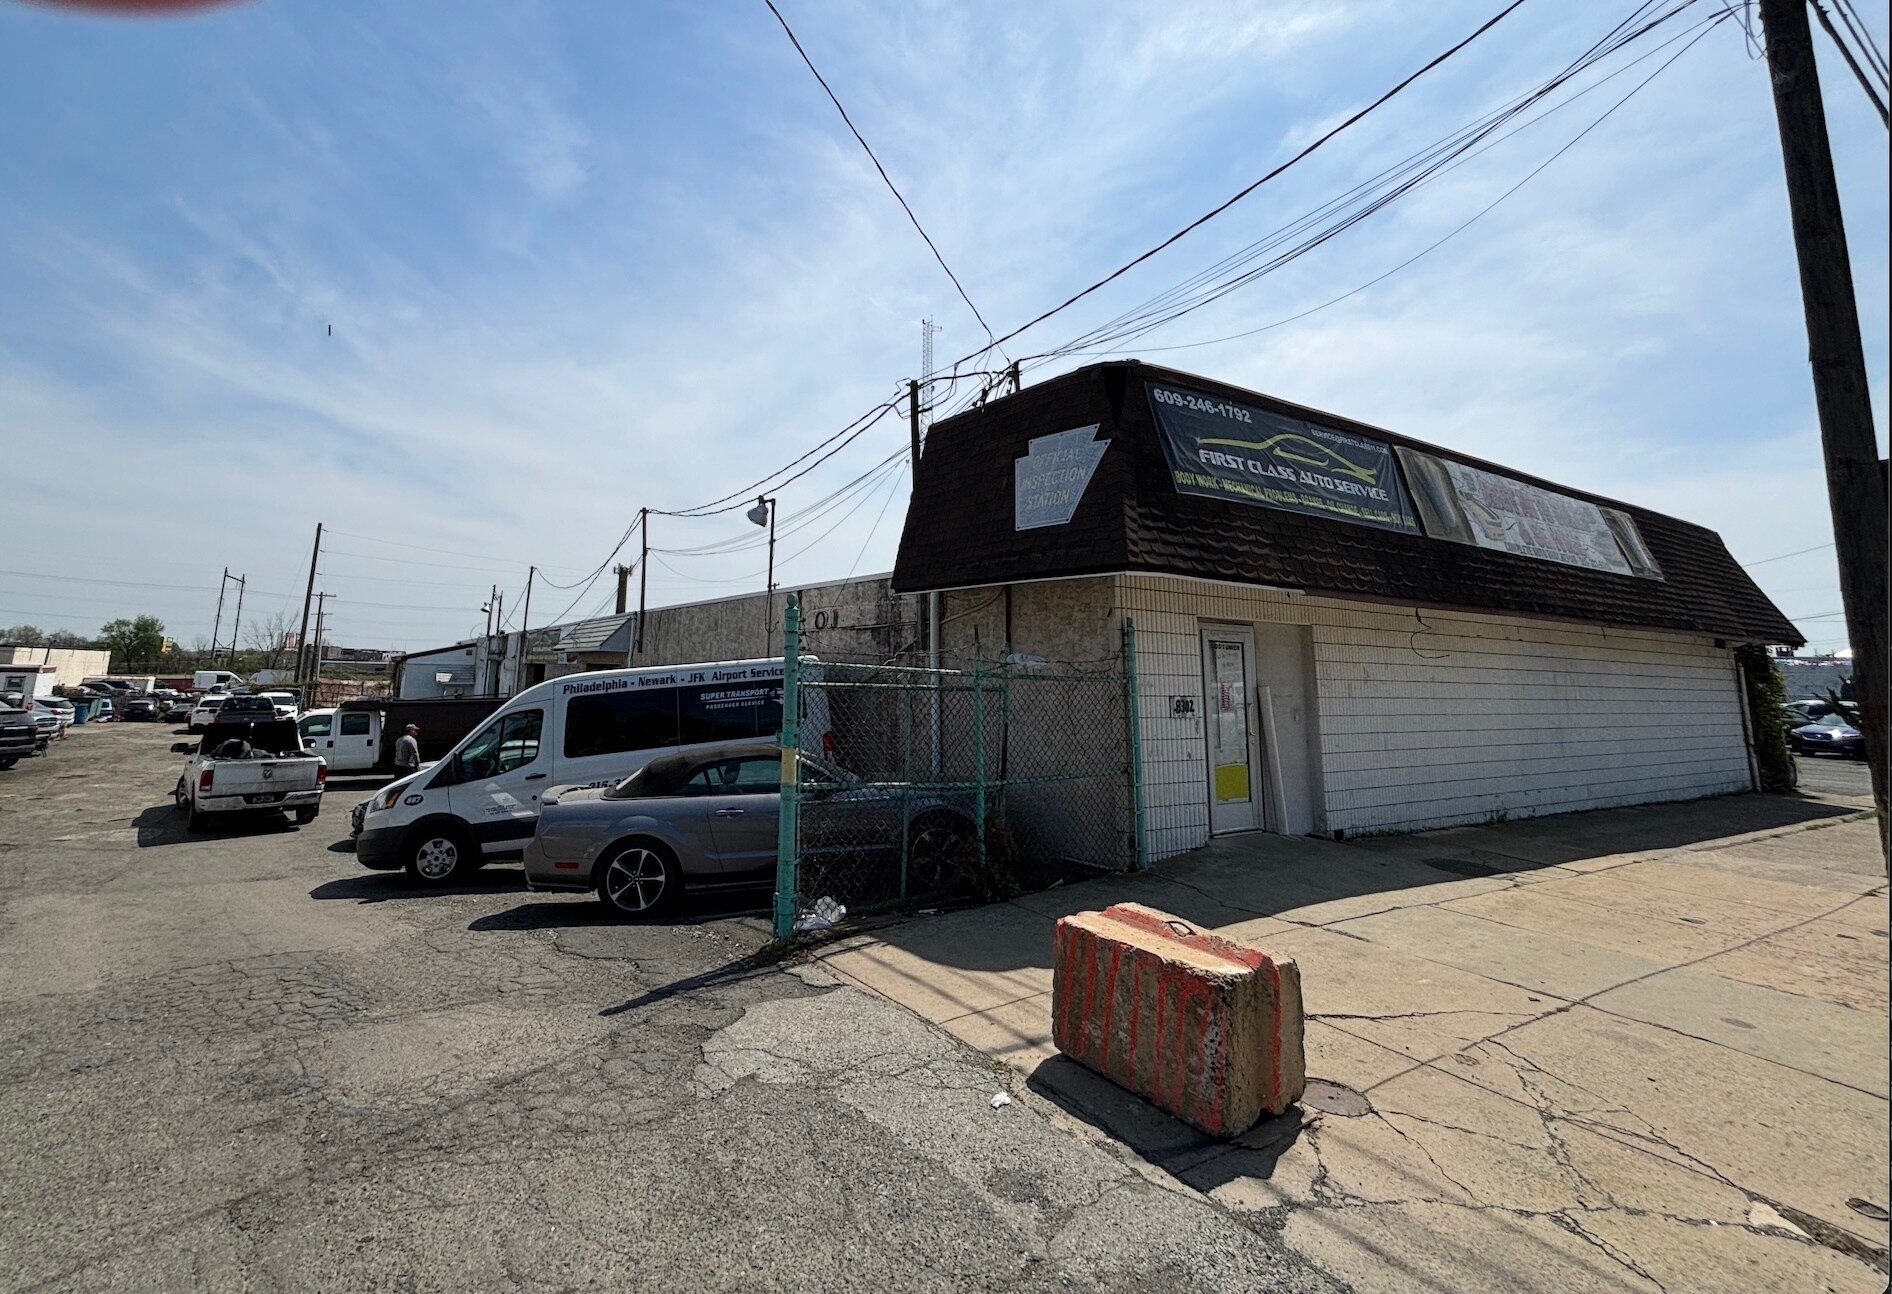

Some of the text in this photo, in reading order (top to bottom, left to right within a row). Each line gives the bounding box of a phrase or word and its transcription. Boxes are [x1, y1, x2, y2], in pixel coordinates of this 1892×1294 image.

[1153, 388, 1252, 423] 609-246-1792
[1033, 447, 1081, 469] OFFICIAL
[1022, 467, 1087, 490] INSPECTION
[1174, 470, 1196, 486] BODY
[1195, 474, 1220, 490] WORK
[1200, 448, 1389, 501] FIRST CLASS AUTO SERVICE
[1027, 489, 1070, 508] STATION
[563, 679, 628, 695] Philadelphia
[638, 675, 677, 687] Newark
[688, 672, 705, 684] JFK
[712, 669, 748, 682] Airport
[700, 688, 769, 700] SUPER TRANSPORT
[706, 699, 765, 709] PASSENGER SERVICE
